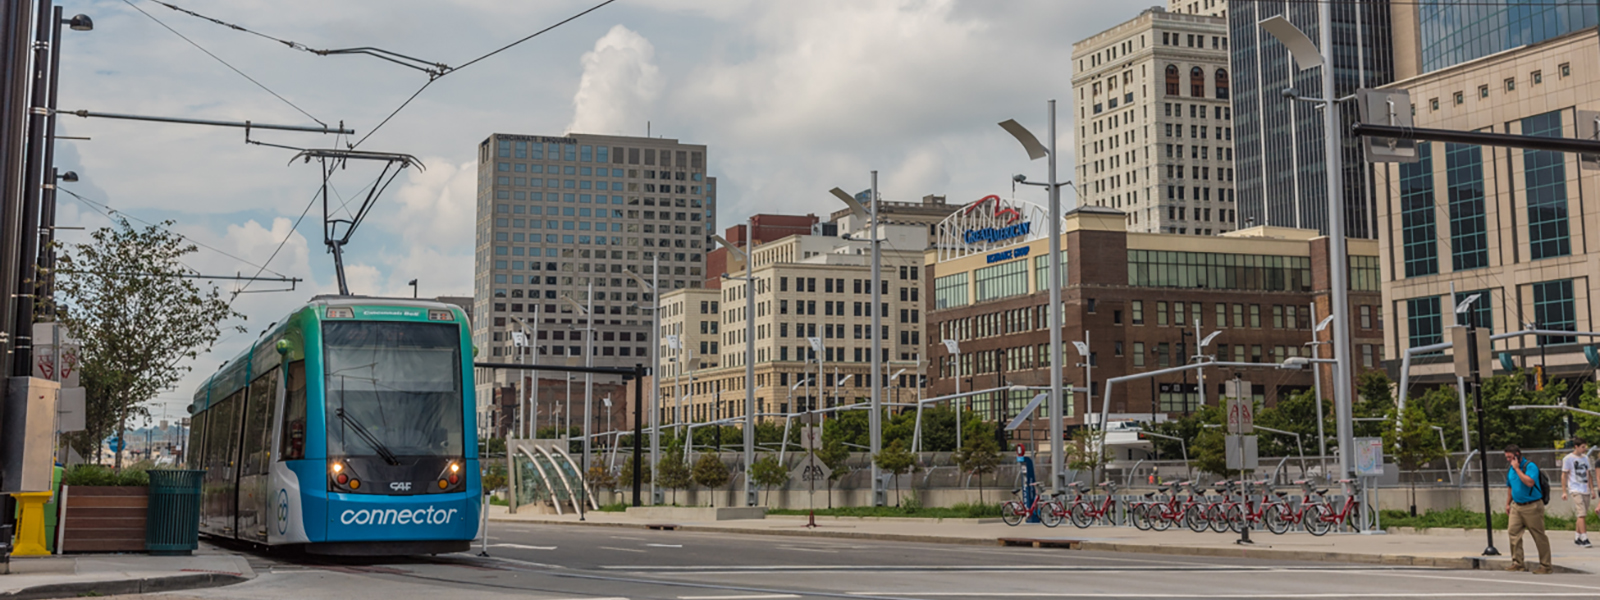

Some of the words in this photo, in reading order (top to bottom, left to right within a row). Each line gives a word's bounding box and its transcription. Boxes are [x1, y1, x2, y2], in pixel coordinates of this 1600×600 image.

[496, 133, 537, 142] CINCINNATI
[541, 136, 577, 144] ENQUIRER
[987, 221, 1030, 244] AMERICAN
[389, 482, 412, 491] CAF
[340, 505, 458, 525] connector
